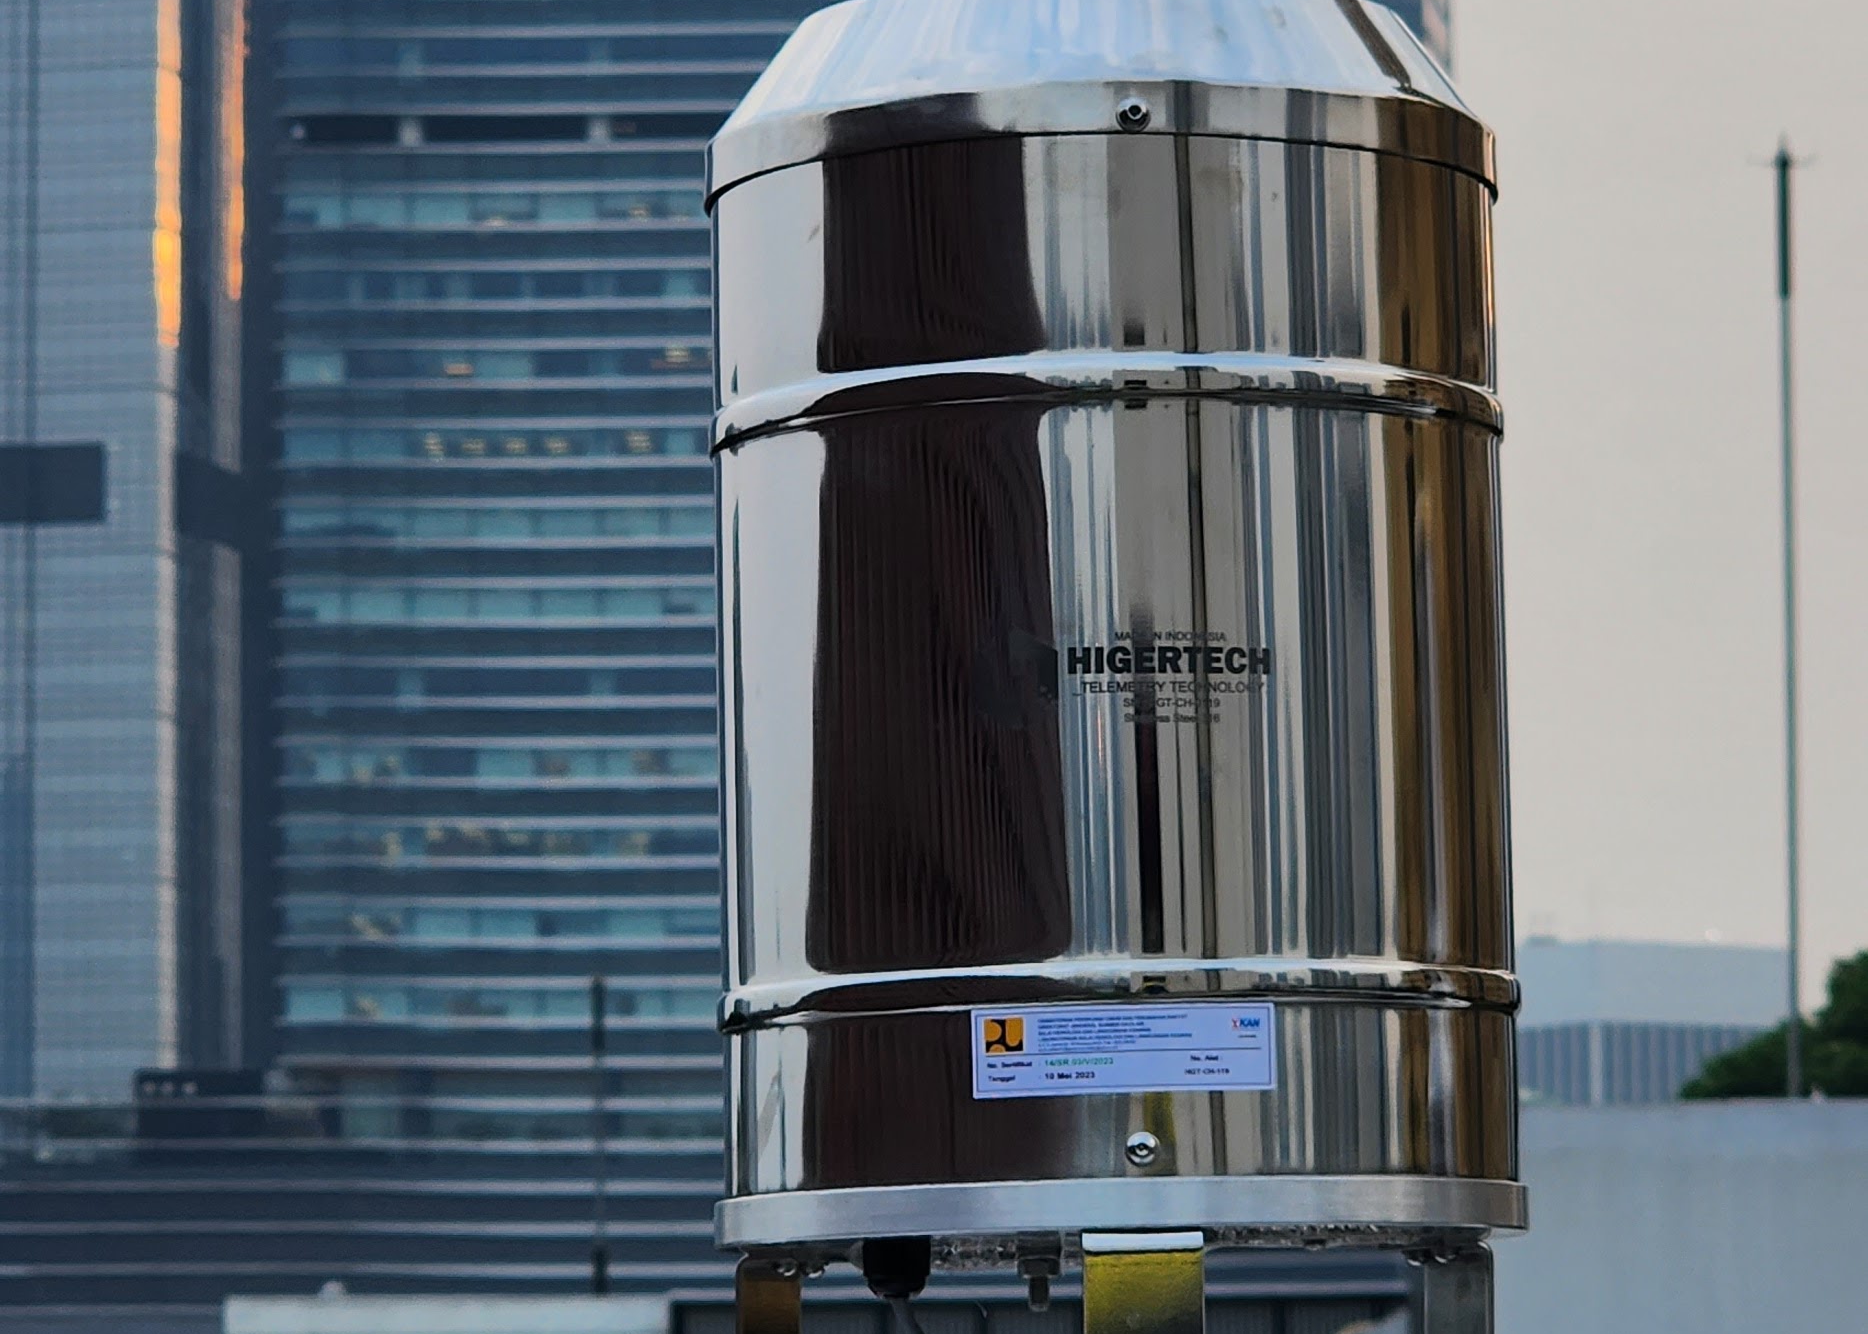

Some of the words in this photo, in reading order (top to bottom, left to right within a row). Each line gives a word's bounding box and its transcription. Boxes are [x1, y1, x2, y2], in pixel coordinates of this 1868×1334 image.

[1067, 646, 1271, 675] HIGERTECH
[1170, 681, 1265, 695] TECHNOLOGY
[1075, 1071, 1096, 1079] 2023
